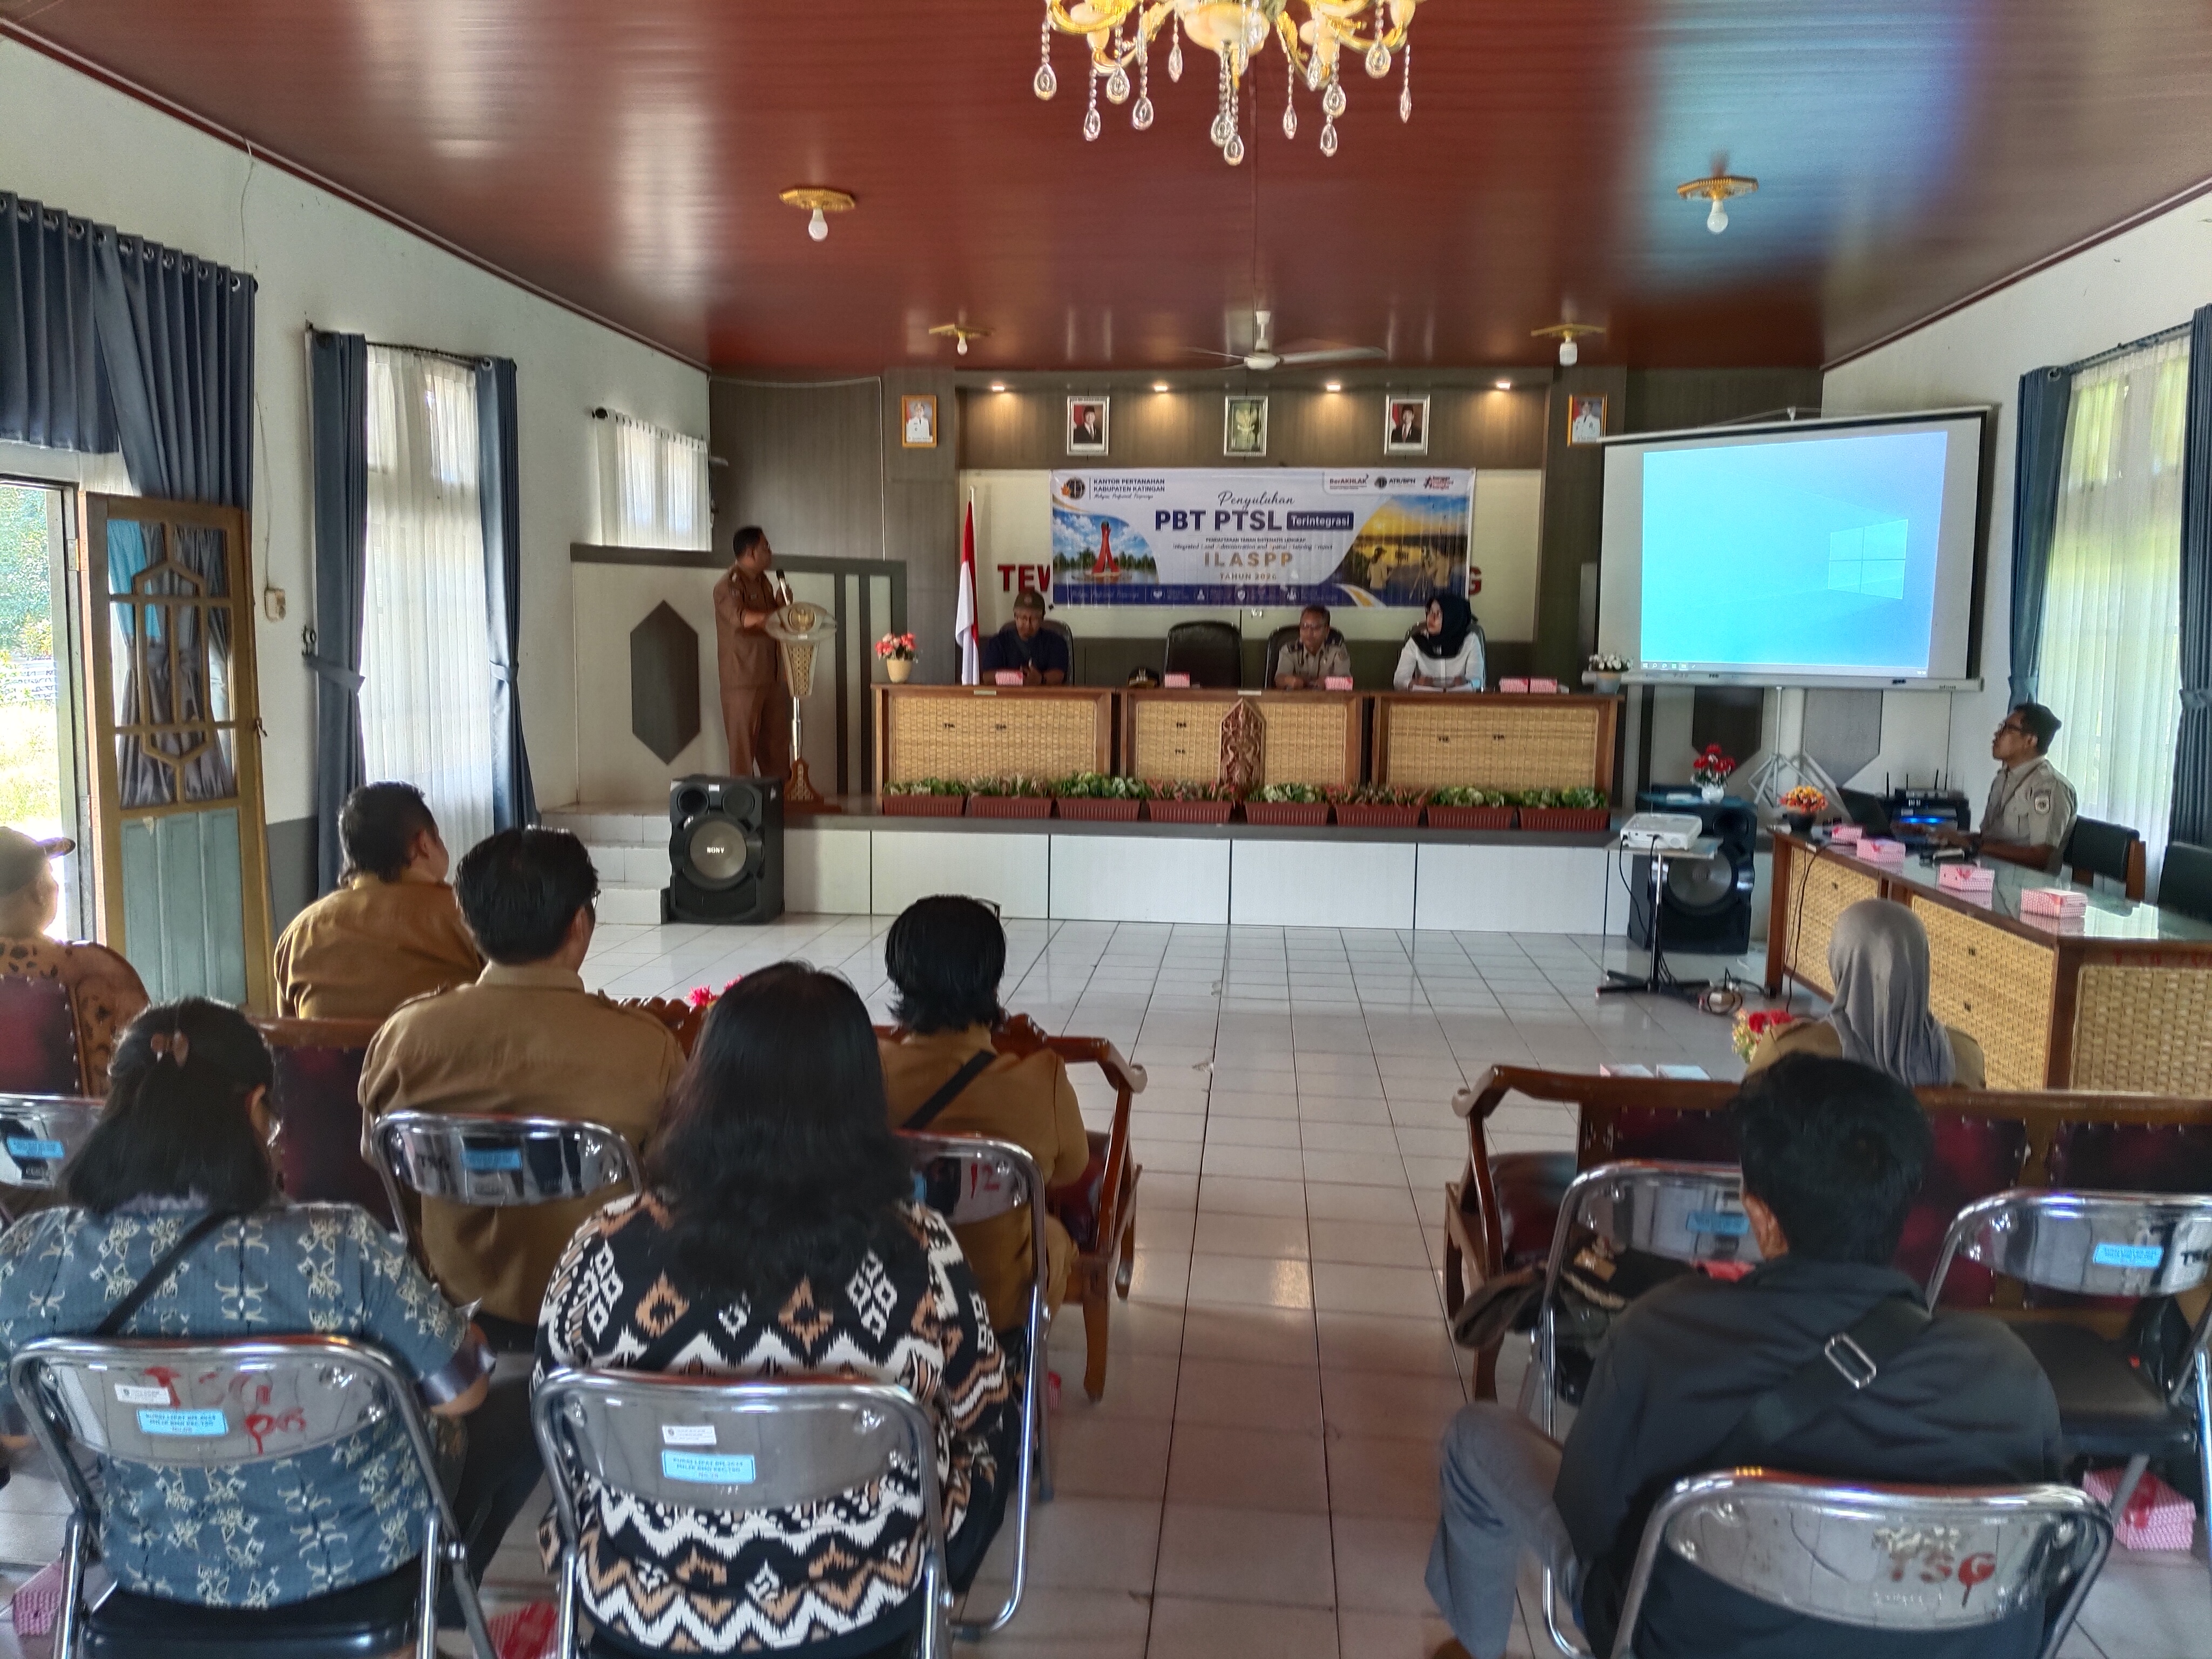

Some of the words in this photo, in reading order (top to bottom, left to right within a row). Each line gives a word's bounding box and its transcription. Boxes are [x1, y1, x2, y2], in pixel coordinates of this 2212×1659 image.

[1217, 490, 1295, 511] Penyuluhan
[1155, 510, 1206, 531] PBT
[1215, 510, 1282, 531] PTSL
[1173, 543, 1199, 551] Integrated
[1204, 551, 1293, 567] ILASPP
[1219, 572, 1252, 581] TAHUN
